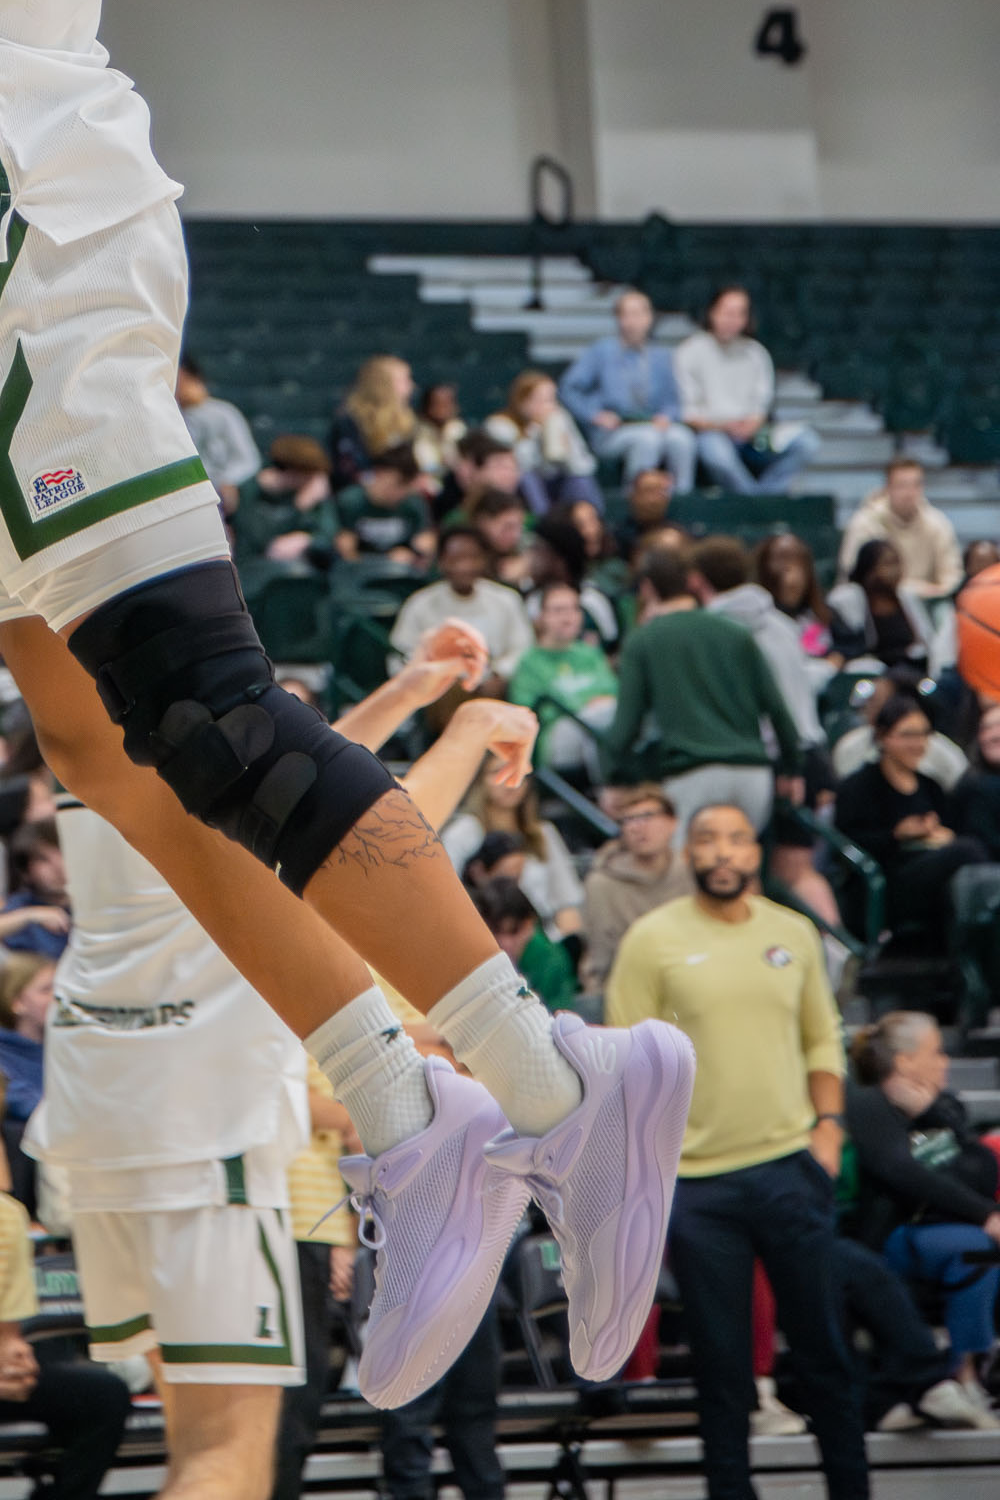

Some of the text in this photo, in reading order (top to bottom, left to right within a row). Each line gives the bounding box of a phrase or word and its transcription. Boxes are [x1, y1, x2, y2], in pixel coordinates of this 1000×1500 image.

[752, 6, 805, 67] 4
[33, 472, 82, 504] PATRIOT
[37, 482, 86, 511] LEAGUE
